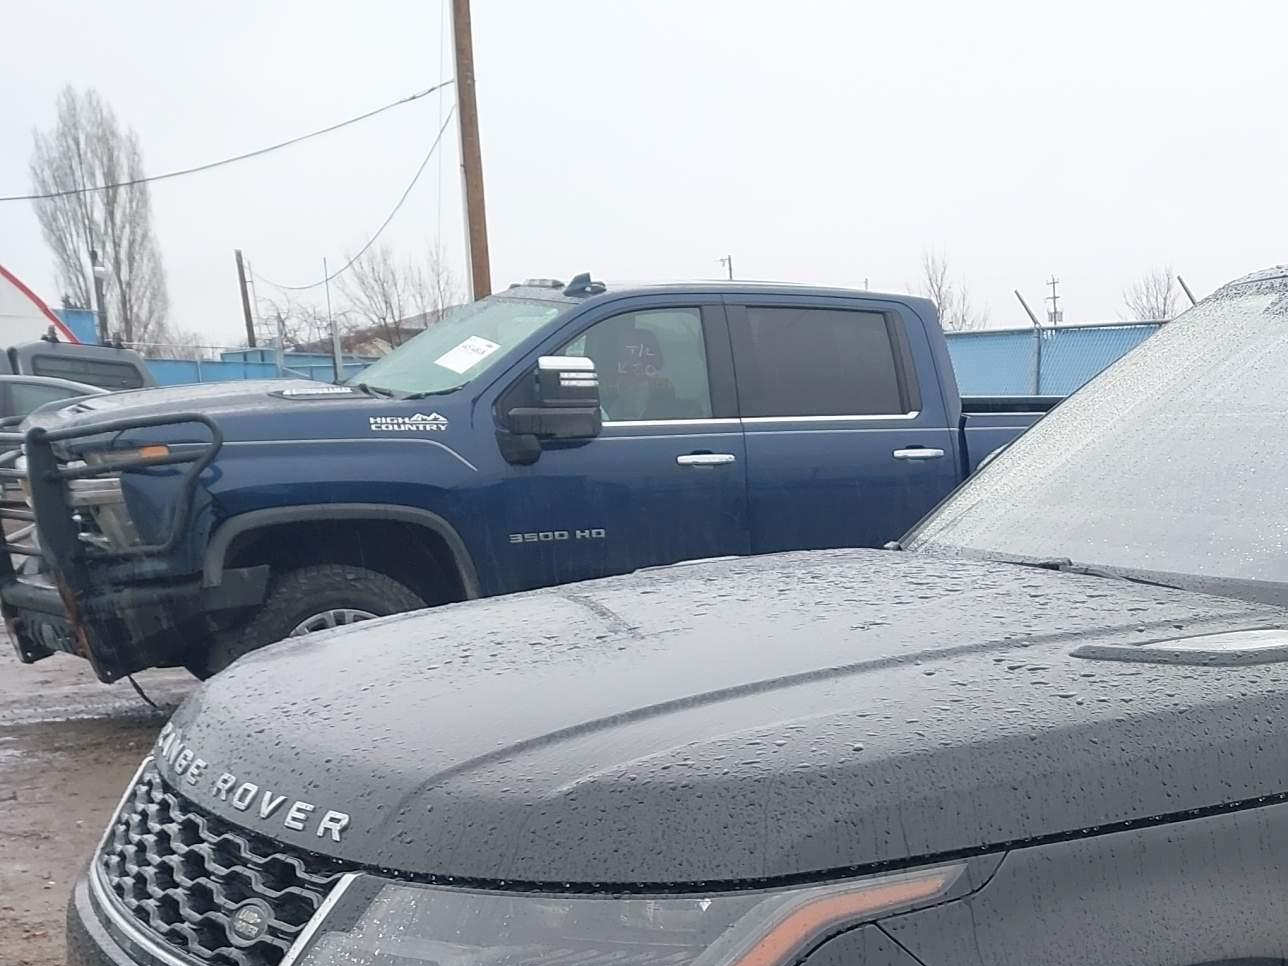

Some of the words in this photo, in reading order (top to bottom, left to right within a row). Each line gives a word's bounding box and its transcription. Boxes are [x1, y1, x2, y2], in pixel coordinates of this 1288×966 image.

[369, 416, 410, 424] HIGH
[370, 423, 448, 431] COUNTRY
[509, 531, 568, 543] 3500
[575, 528, 606, 539] HD
[213, 772, 350, 841] ROVER
